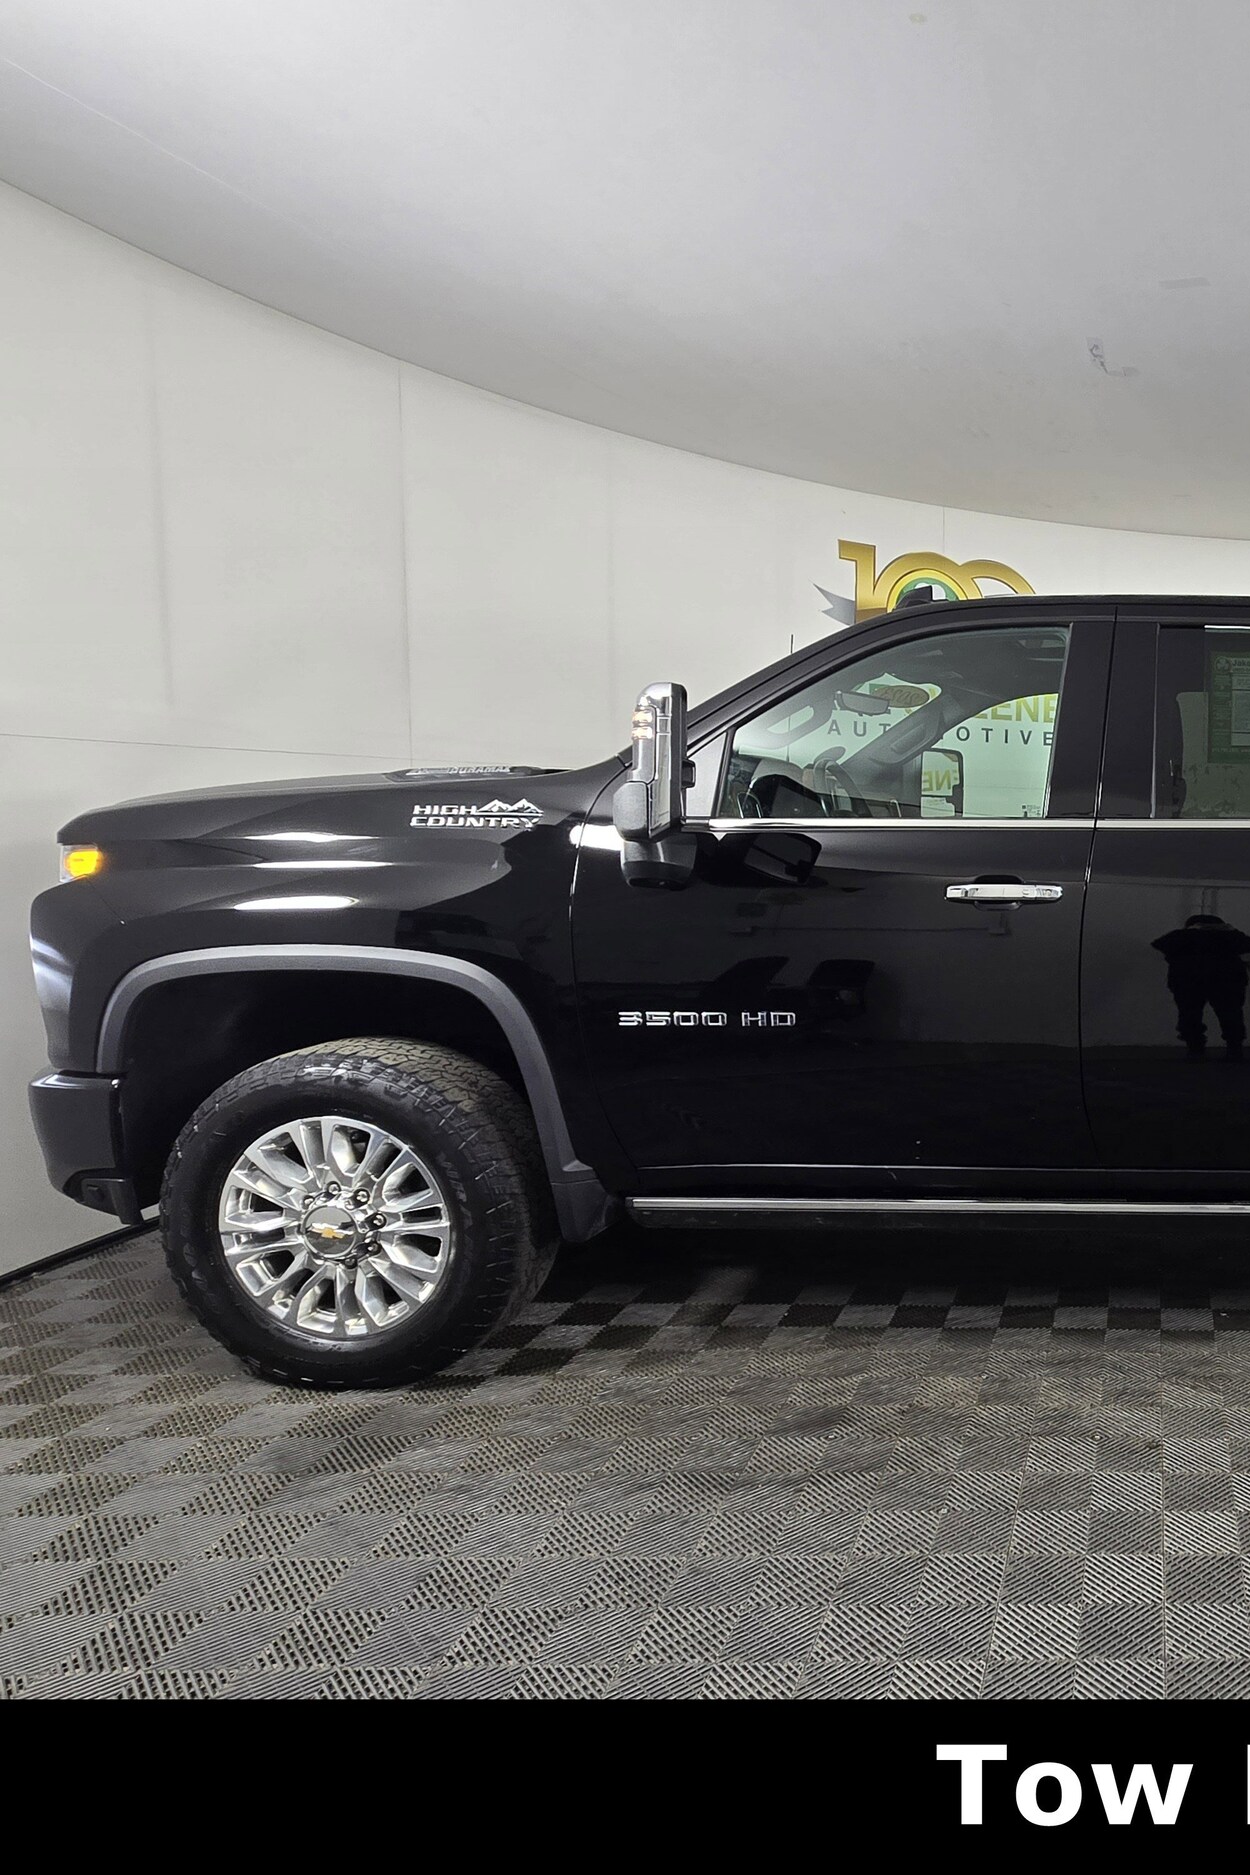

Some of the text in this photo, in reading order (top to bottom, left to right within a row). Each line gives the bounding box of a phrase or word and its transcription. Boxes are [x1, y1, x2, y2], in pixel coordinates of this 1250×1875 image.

[827, 719, 1055, 747] AUTOTIVE
[412, 805, 479, 816] HIGH
[409, 816, 541, 828] COUNTRY
[618, 1010, 796, 1027] 3500 HD
